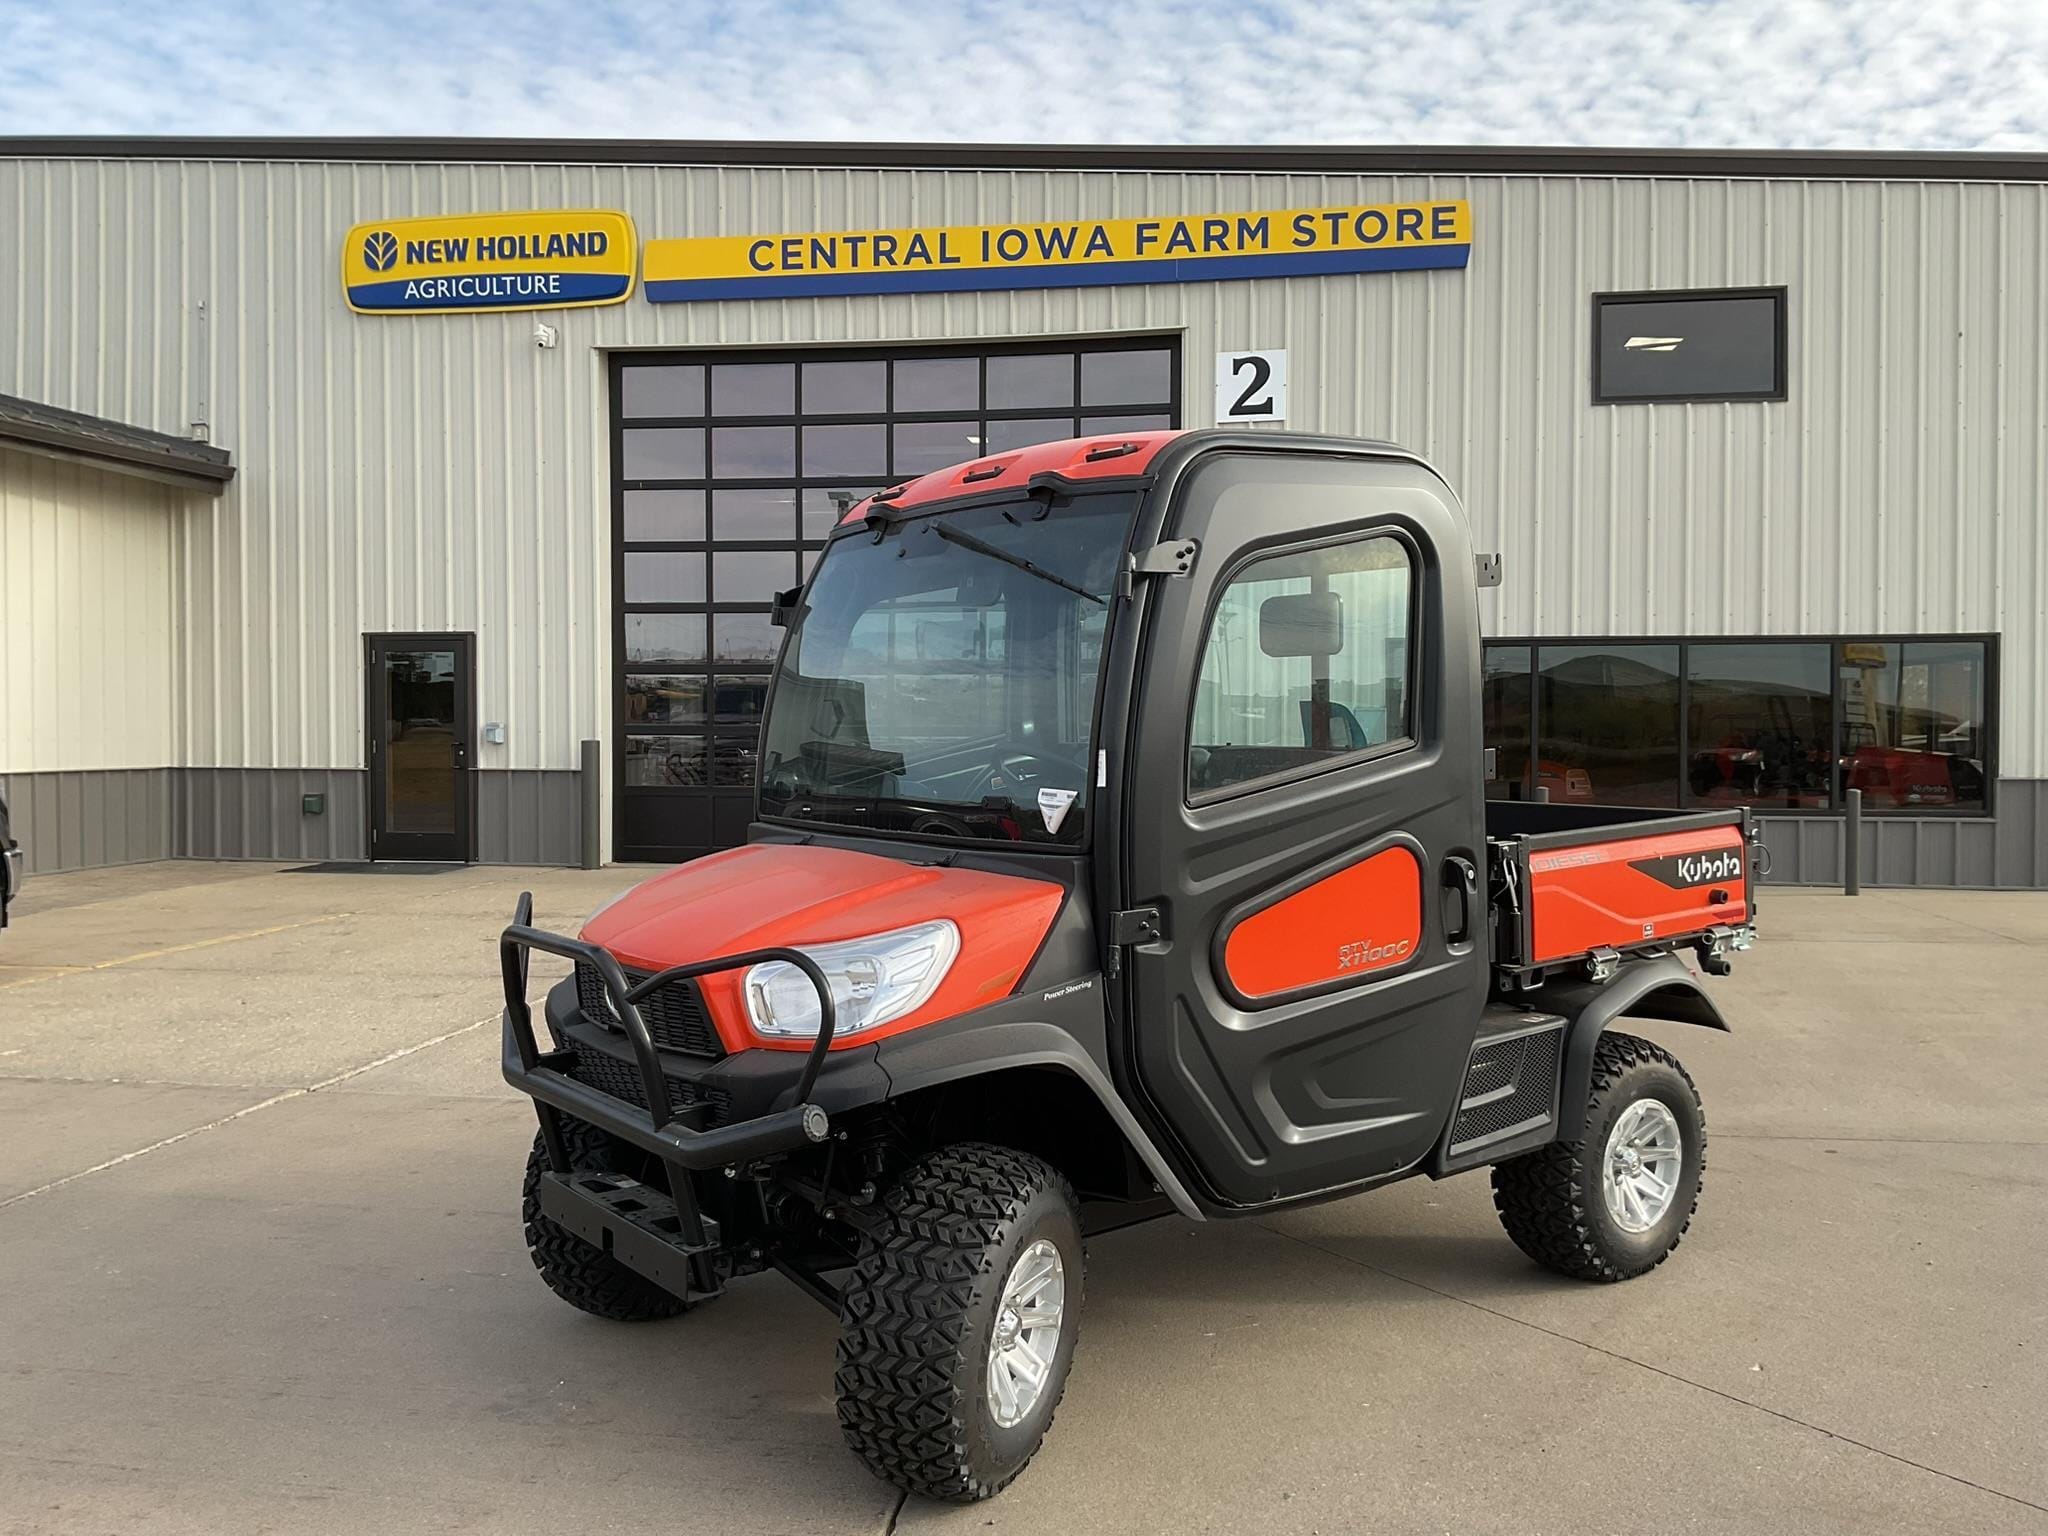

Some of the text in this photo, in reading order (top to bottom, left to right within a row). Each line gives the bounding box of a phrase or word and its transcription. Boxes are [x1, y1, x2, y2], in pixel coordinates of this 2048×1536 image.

[406, 231, 608, 265] NEW HOLLAND
[749, 206, 1457, 272] CENTRAL IOWA FARM STORE
[404, 275, 561, 300] AGRICULTURE
[1228, 356, 1274, 416] 2
[1535, 851, 1608, 870] DIESEL
[1677, 852, 1741, 883] Kubota
[1337, 940, 1409, 970] X1100C
[1339, 939, 1372, 956] RTV
[1043, 980, 1093, 1001] Power Steering
